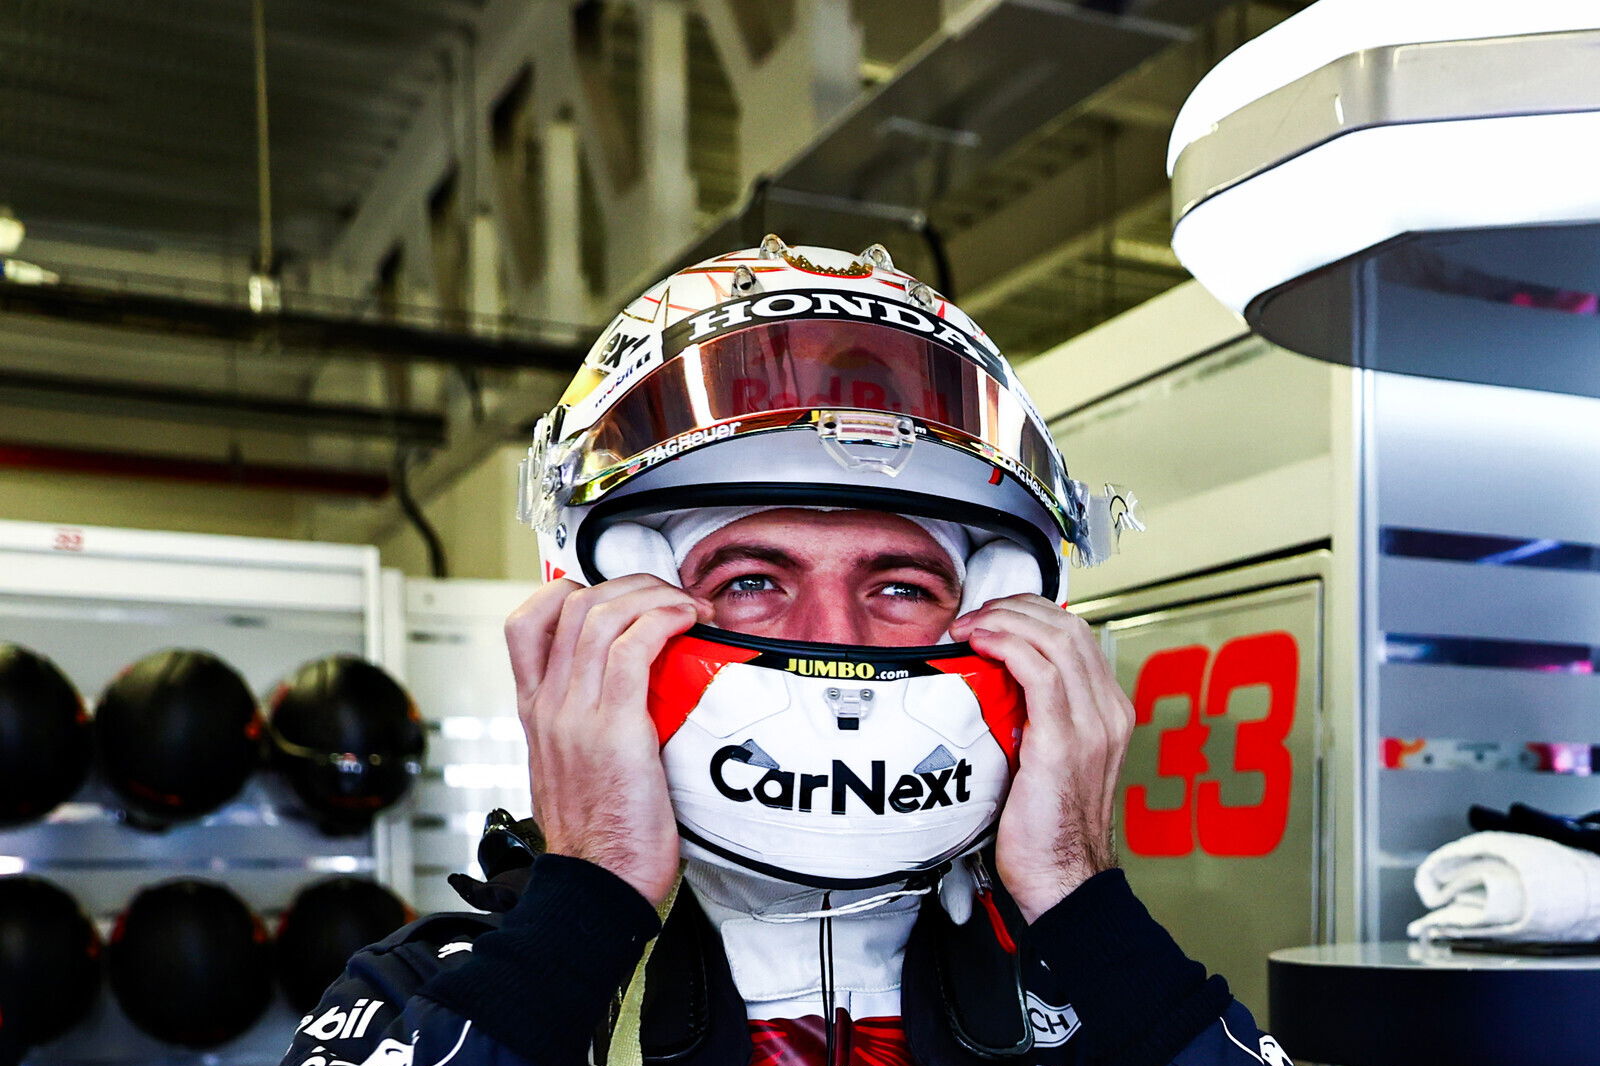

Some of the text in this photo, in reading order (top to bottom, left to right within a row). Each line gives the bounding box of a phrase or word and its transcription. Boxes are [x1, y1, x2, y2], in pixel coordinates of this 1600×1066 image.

[687, 292, 988, 368] HONDA
[784, 656, 909, 681] JUMBO.com
[709, 744, 973, 815] CarNext
[1123, 629, 1300, 858] 33
